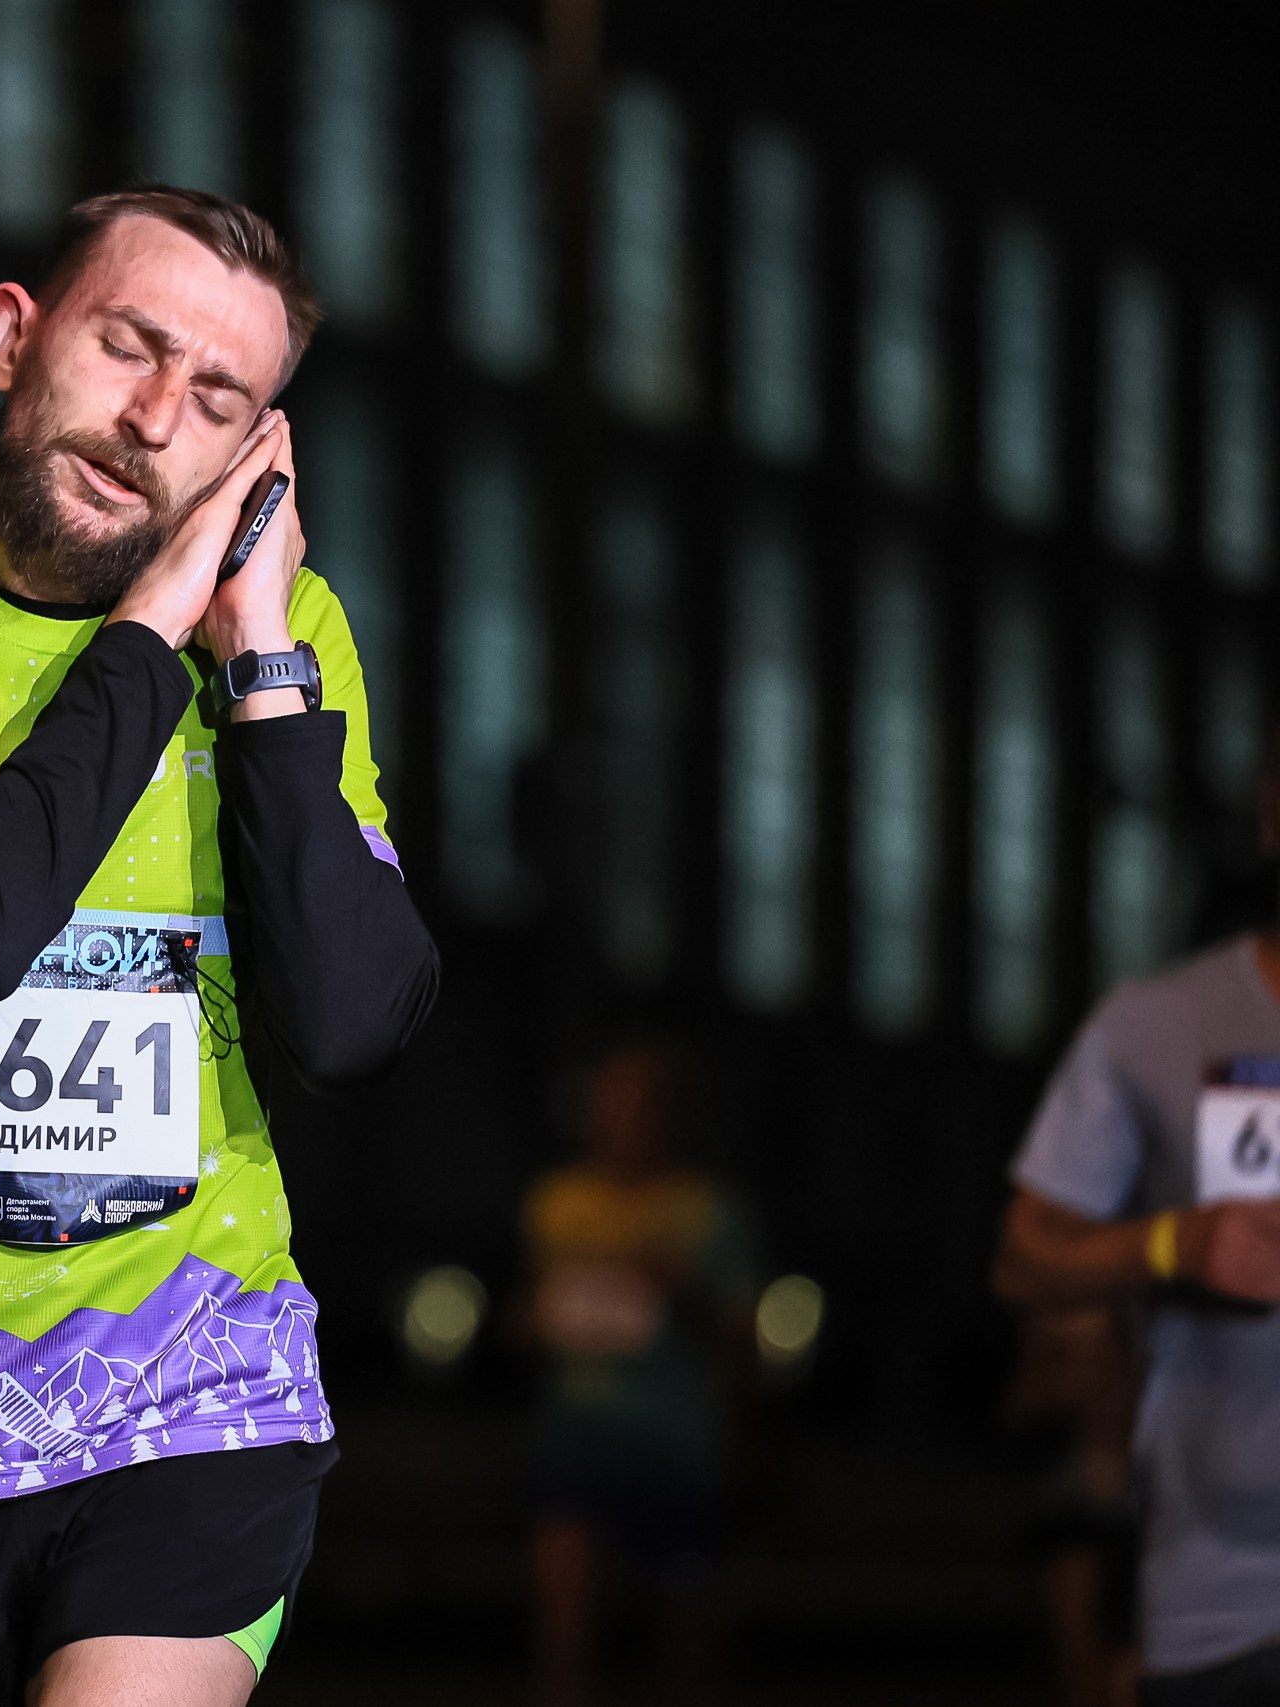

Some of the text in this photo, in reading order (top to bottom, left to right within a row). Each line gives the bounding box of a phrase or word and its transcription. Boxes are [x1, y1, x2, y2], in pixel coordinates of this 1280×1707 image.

[31, 927, 164, 977] НОЙ
[1231, 1110, 1272, 1178] 6
[6, 1198, 50, 1206] Департамент
[105, 1199, 165, 1213] МОСКОВСКИЙ
[6, 1206, 29, 1214] спорта
[30, 1213, 57, 1222] Москвы
[104, 1212, 134, 1224] СПОРТ
